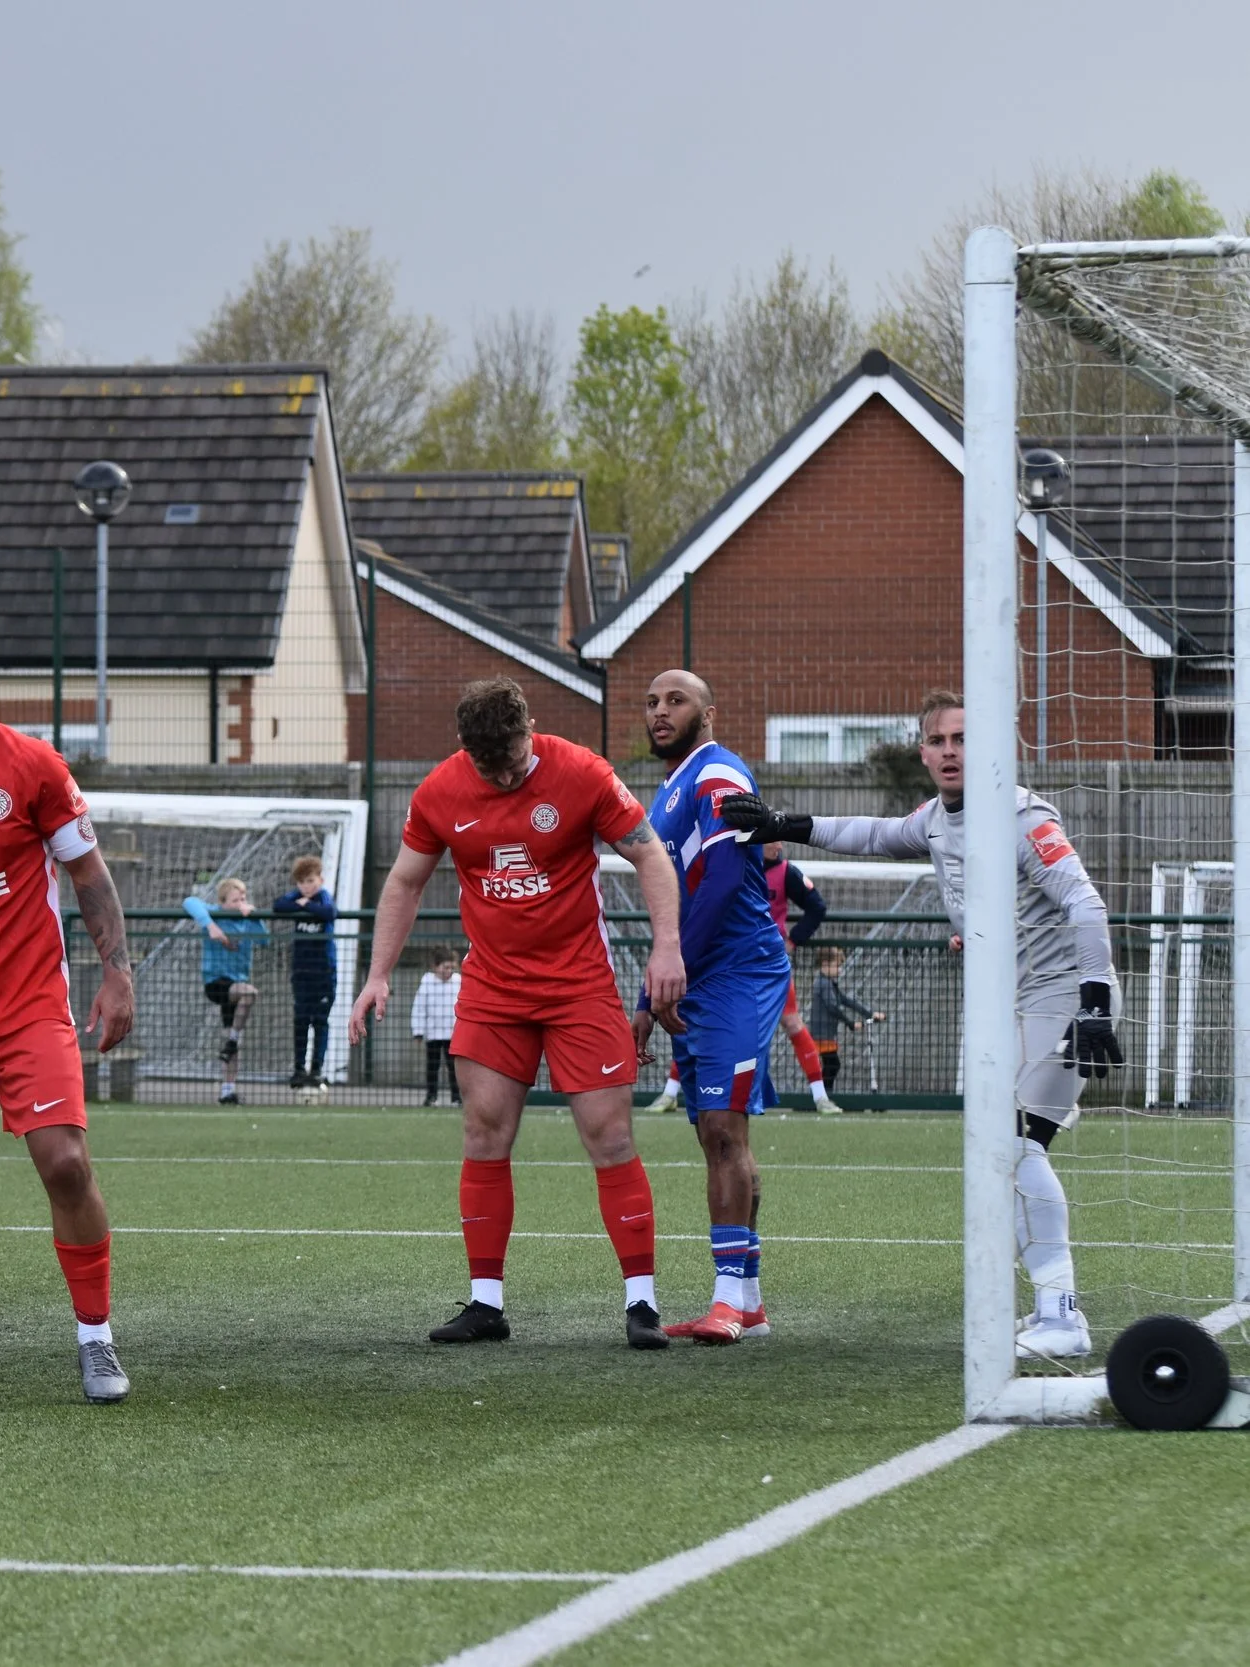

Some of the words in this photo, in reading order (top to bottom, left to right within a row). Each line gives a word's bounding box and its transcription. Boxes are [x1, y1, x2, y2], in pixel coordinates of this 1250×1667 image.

[481, 873, 551, 899] FOSSE
[700, 1086, 724, 1095] VX3
[716, 1265, 745, 1276] VX3
